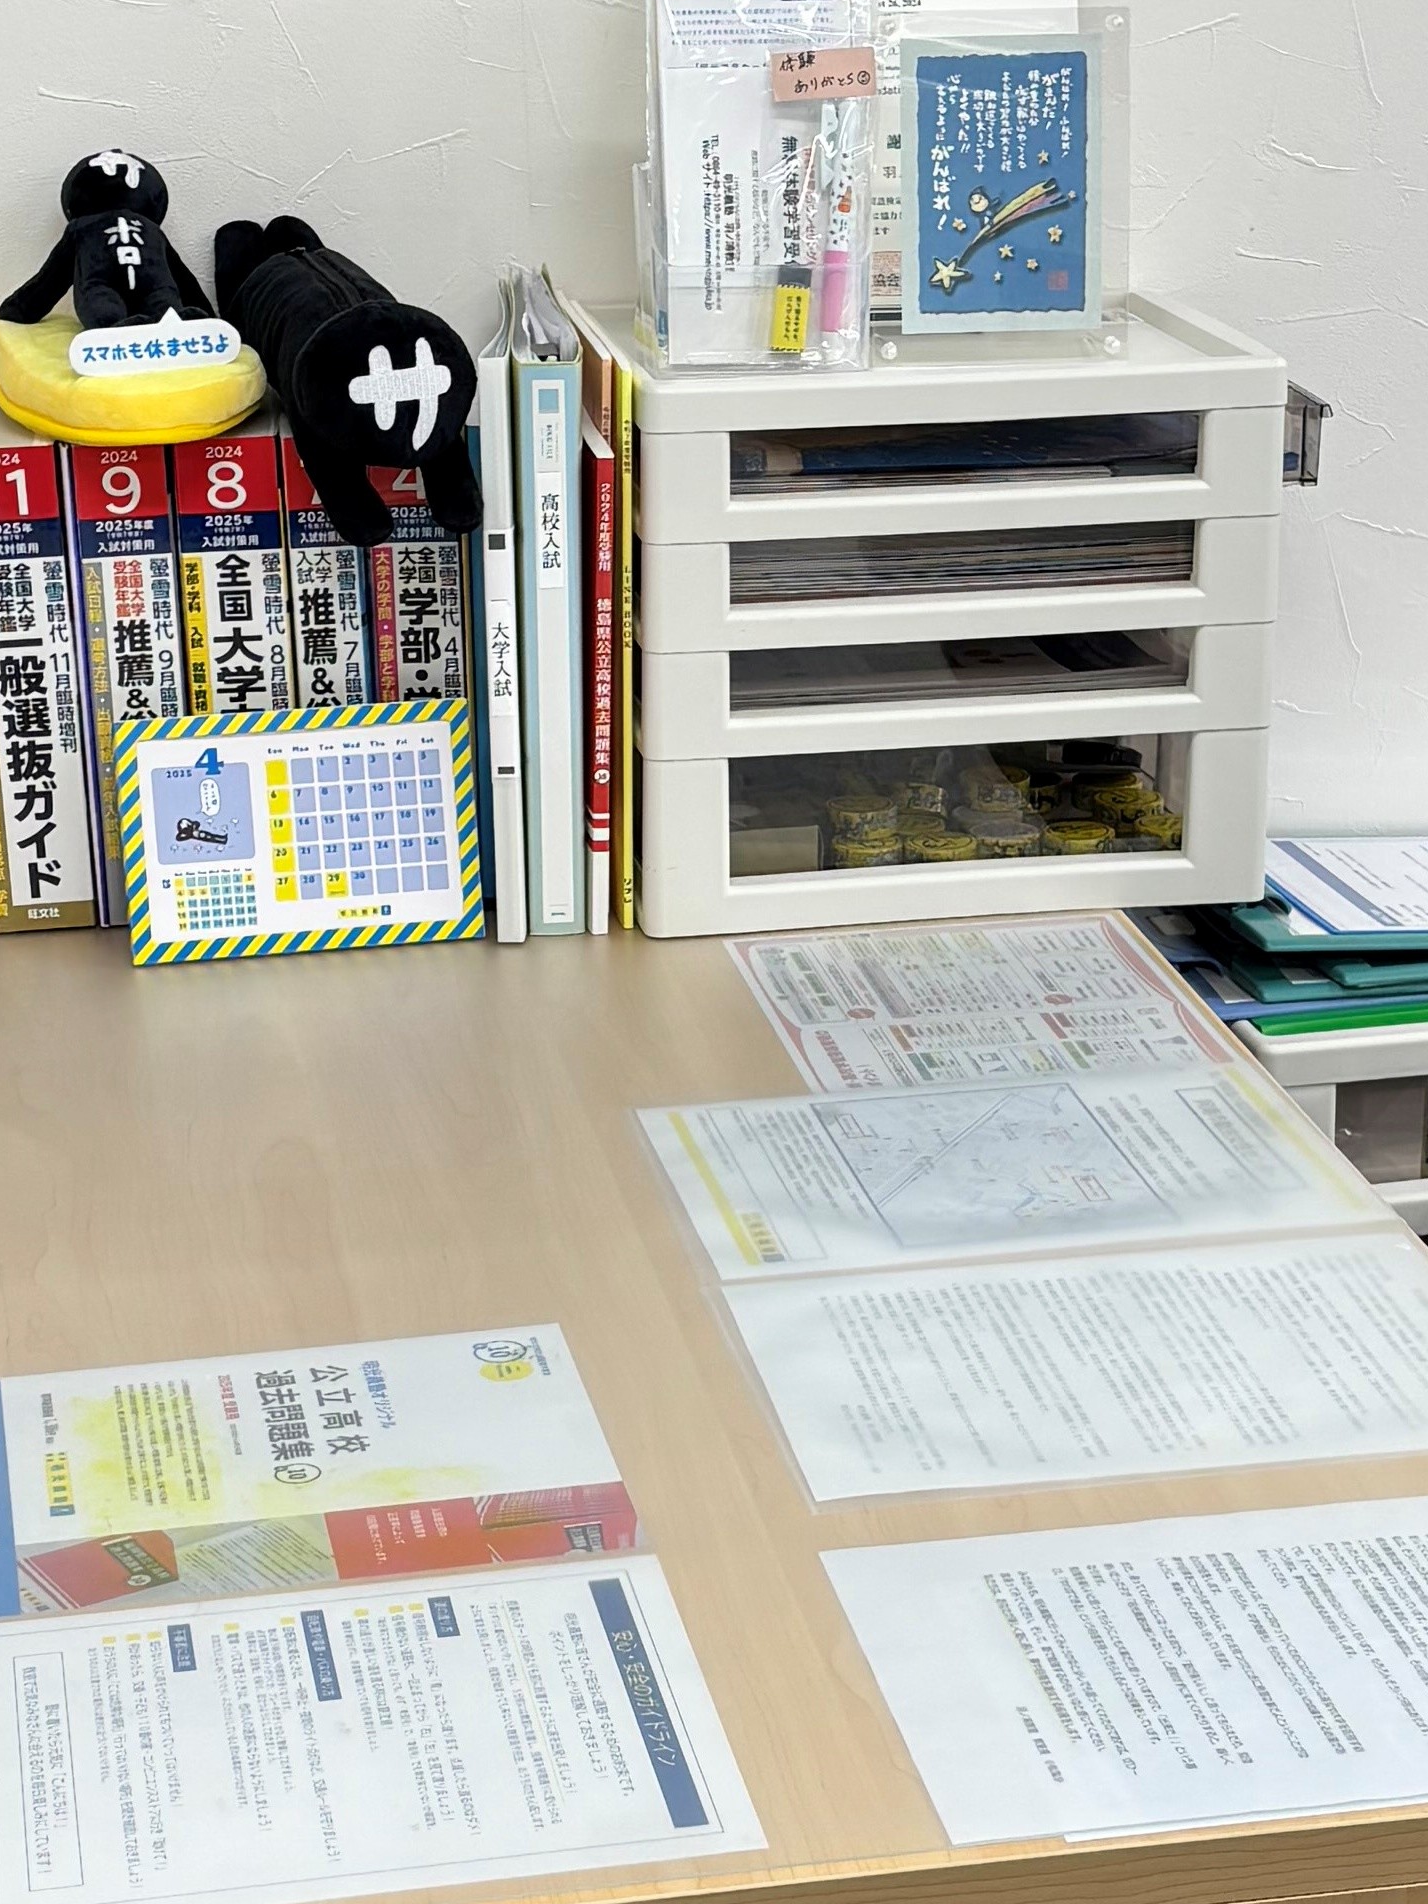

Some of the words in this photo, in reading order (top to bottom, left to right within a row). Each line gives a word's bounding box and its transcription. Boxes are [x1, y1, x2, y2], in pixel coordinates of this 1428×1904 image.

[103, 216, 144, 290] ボロー
[82, 339, 231, 363] スマホも休ませろよ
[348, 336, 452, 451] サ
[101, 449, 138, 464] 2024
[205, 445, 243, 459] 2024
[101, 465, 142, 514] 9
[206, 461, 245, 510] 8
[95, 520, 154, 533] 2025年度
[201, 535, 259, 548] 入試対策用
[204, 515, 254, 527] 2025年
[541, 493, 561, 569] 高校入試
[97, 540, 155, 553] 入試対策用
[296, 550, 314, 584] 入試
[313, 550, 333, 584] 大学
[398, 548, 417, 584] 大学
[417, 548, 436, 583] 全国
[13, 564, 36, 632] 全国大学
[113, 561, 131, 618] 受験年鑑
[128, 560, 146, 616] 全国大学
[491, 621, 513, 698] 大学入試
[595, 596, 613, 766] 徳島県公立高校過去問題集
[195, 747, 224, 776] 4
[28, 908, 60, 919] 旺文社
[251, 1368, 316, 1462] 過去問題集
[305, 1362, 372, 1456] 公立高校
[608, 1628, 681, 1767] 安心・安全のガイドライン
